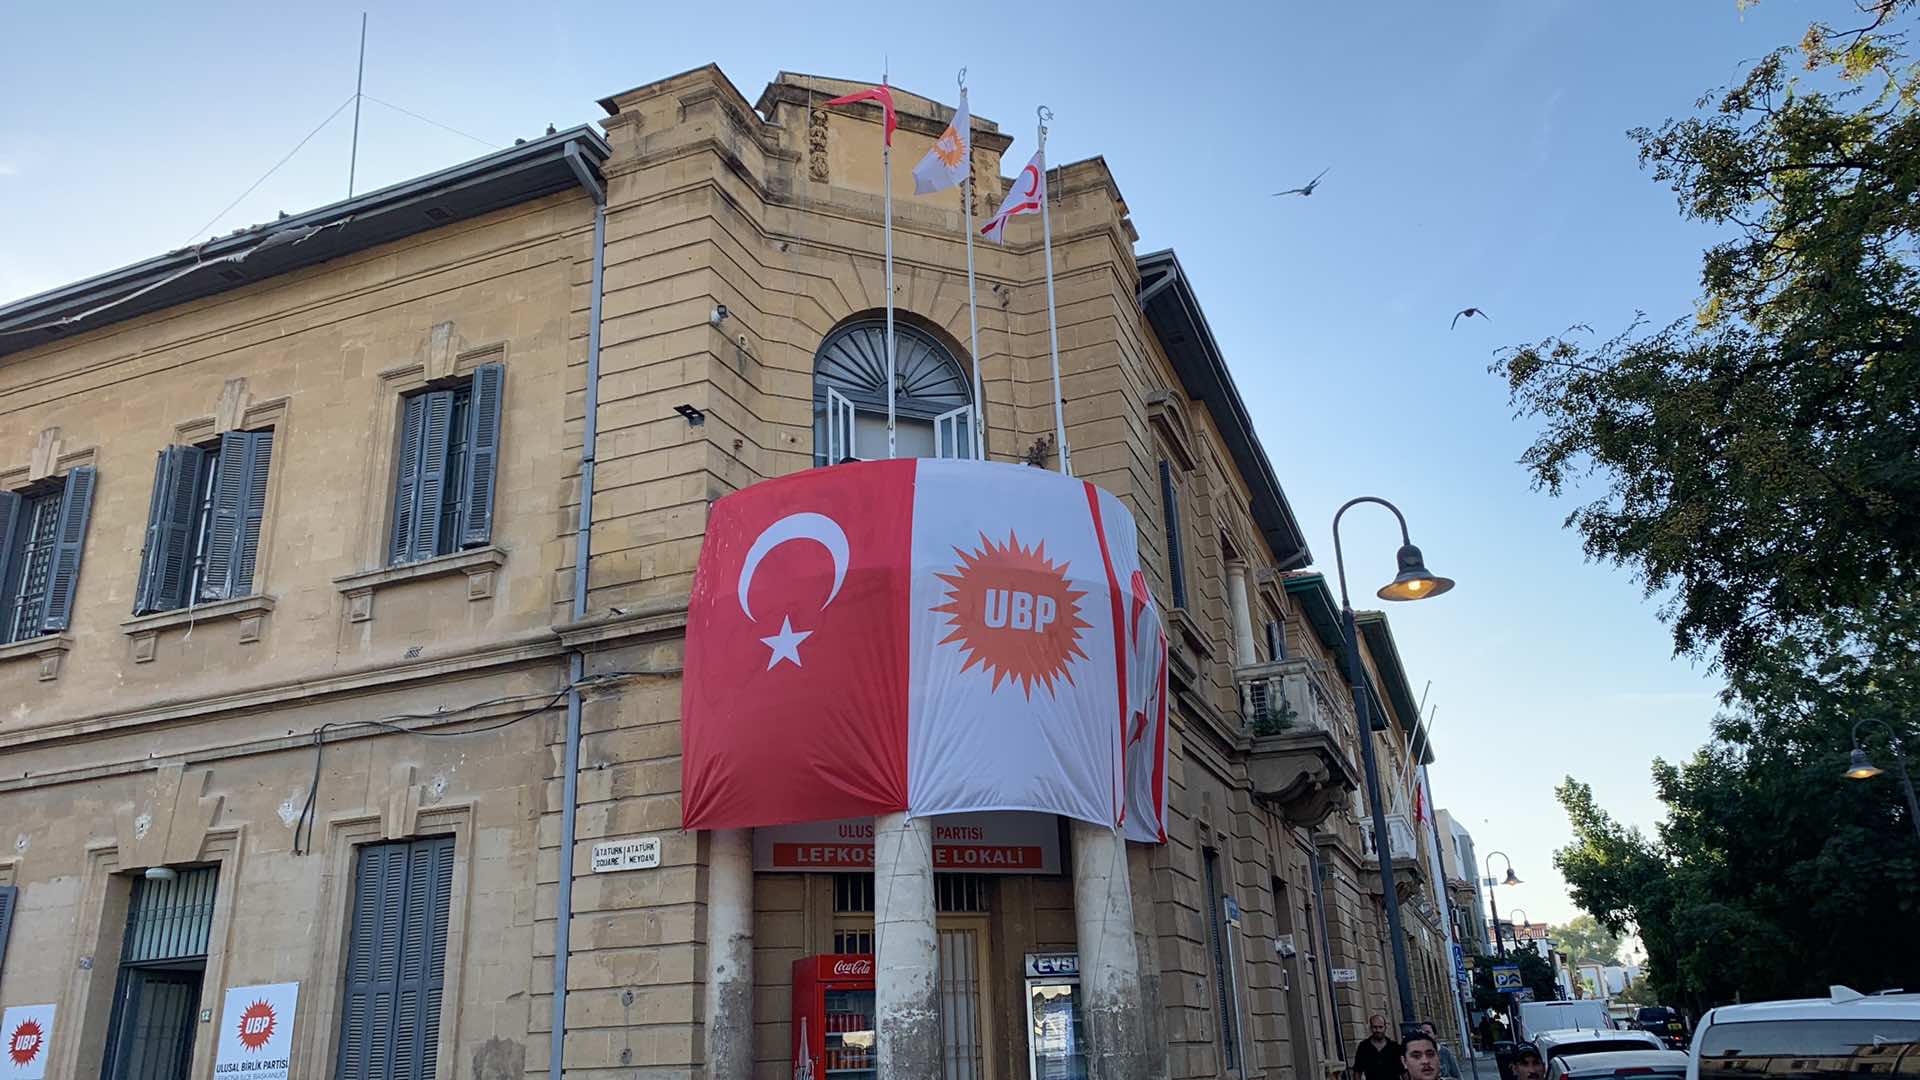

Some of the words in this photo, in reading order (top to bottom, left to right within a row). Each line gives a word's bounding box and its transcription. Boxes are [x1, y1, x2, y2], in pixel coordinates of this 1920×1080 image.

[985, 588, 1056, 633] UBP
[596, 857, 620, 867] SQUARE
[953, 847, 1024, 865] LOKALİ
[245, 1016, 270, 1035] UBP
[15, 1035, 38, 1051] UBP
[216, 1063, 240, 1073] ULUSAL
[241, 1060, 262, 1072] BİRLİK
[263, 1057, 289, 1070] PARTİSİ
